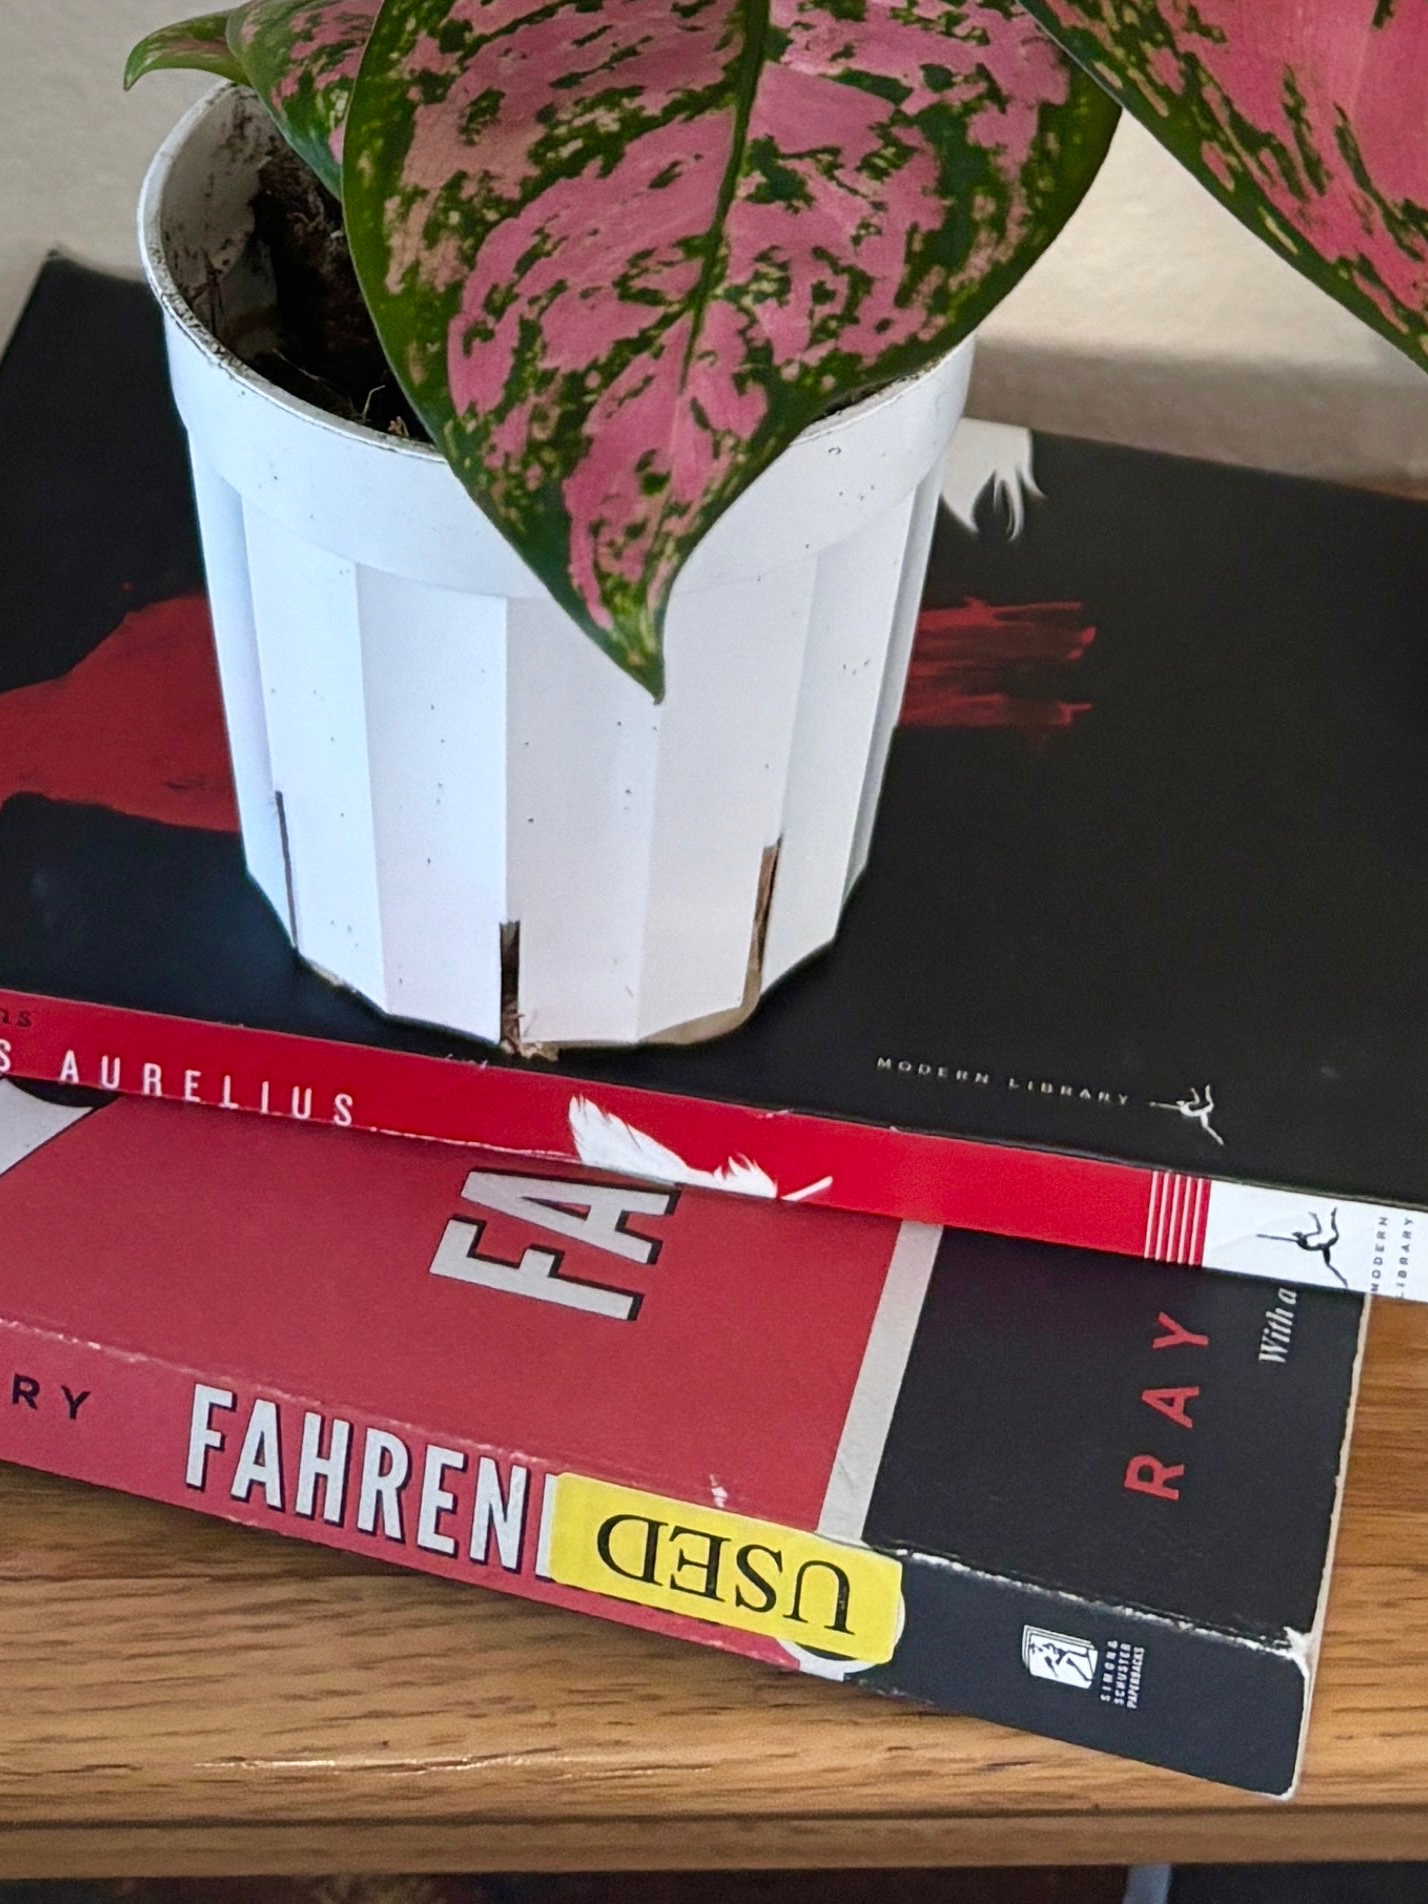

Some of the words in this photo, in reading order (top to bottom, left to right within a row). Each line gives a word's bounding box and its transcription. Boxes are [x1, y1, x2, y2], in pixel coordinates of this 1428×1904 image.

[59, 1049, 353, 1128] AURELIUS
[877, 1057, 990, 1085] MODERN
[1008, 1077, 1128, 1105] LIBRARY
[1370, 1216, 1389, 1292] MODERN
[1258, 1308, 1294, 1363] With
[1278, 1287, 1298, 1305] a
[1124, 1311, 1209, 1501] RAY
[596, 1511, 856, 1636] USED
[1100, 1651, 1117, 1702] SIMON
[1114, 1643, 1131, 1705] SCHUSTER
[1126, 1647, 1145, 1709] PAPERBACKS
